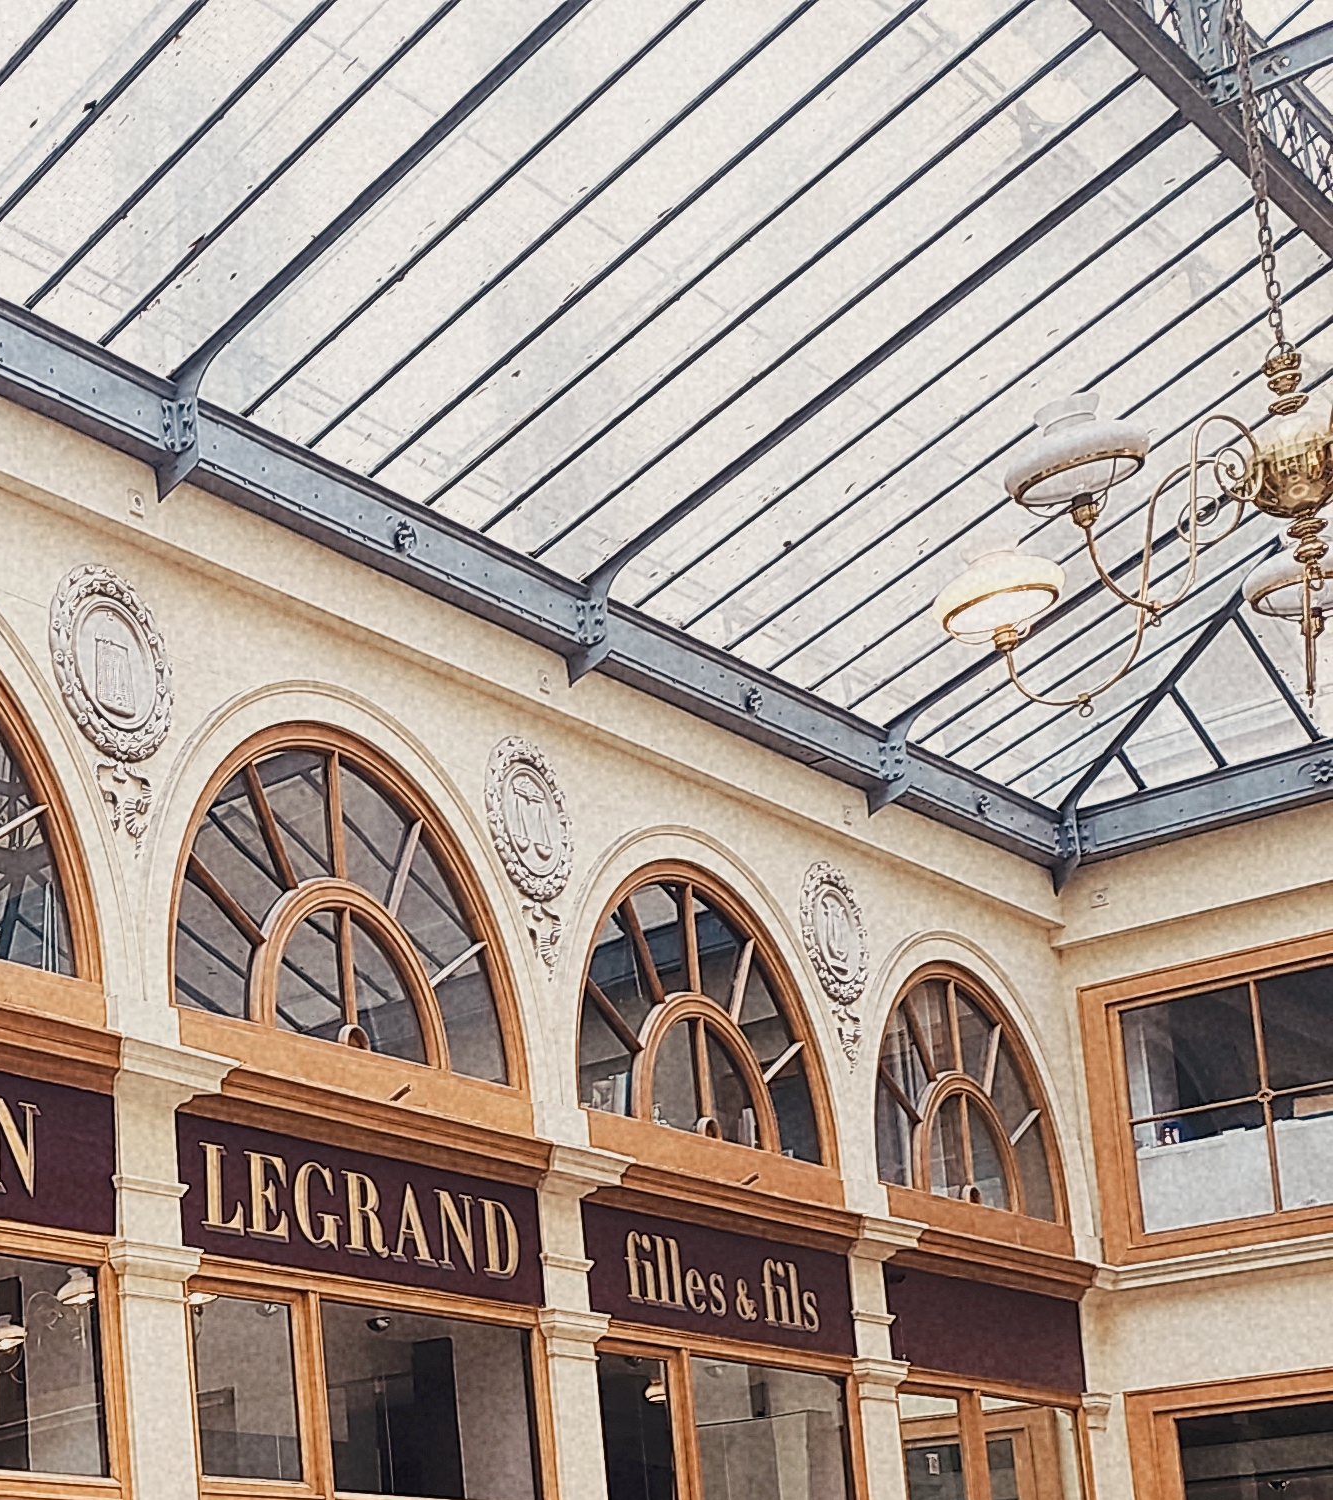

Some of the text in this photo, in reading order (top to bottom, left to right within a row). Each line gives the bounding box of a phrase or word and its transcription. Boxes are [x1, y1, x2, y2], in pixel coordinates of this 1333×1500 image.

[198, 1141, 520, 1280] LEGRAND
[624, 1230, 821, 1333] filles & fils
